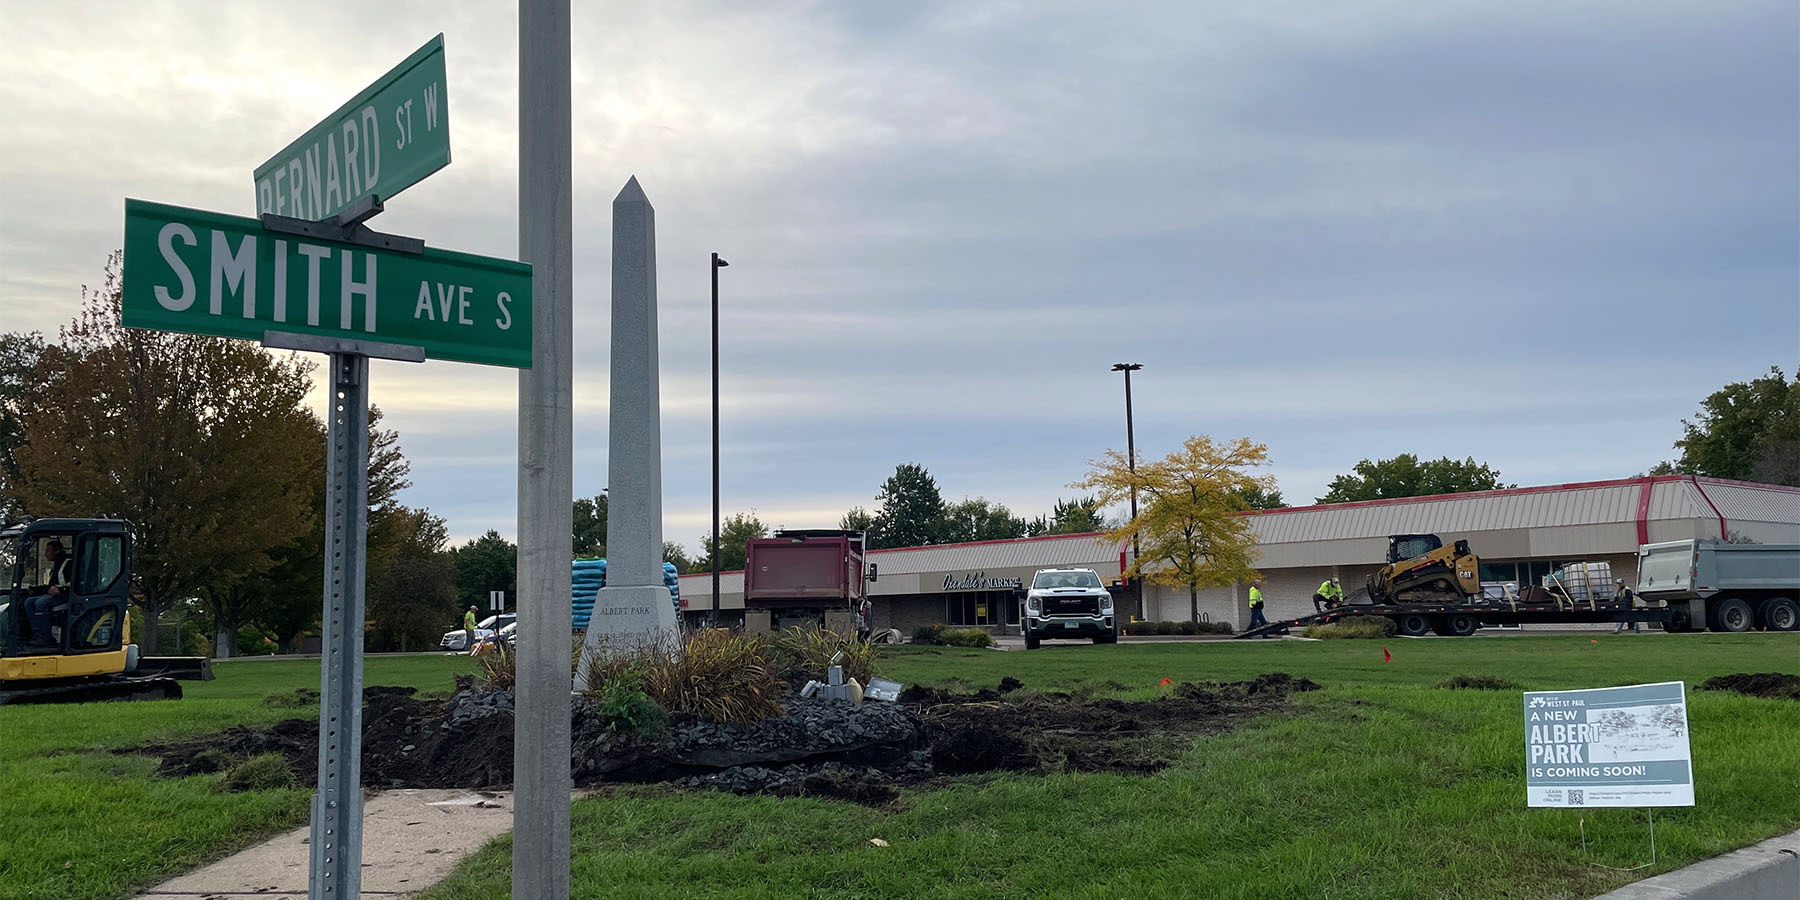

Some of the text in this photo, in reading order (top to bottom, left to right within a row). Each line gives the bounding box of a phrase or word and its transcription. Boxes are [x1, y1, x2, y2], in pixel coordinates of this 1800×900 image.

[260, 81, 437, 221] BERNARD ST W
[154, 222, 512, 333] SMITH AVE S
[1459, 570, 1472, 578] CAT
[599, 607, 651, 616] ALBERT PARK
[1530, 710, 1578, 721] A NEW
[1530, 723, 1601, 744] ALBERT
[1531, 743, 1584, 764] PARK
[1531, 765, 1647, 777] IS COMING SOON!
